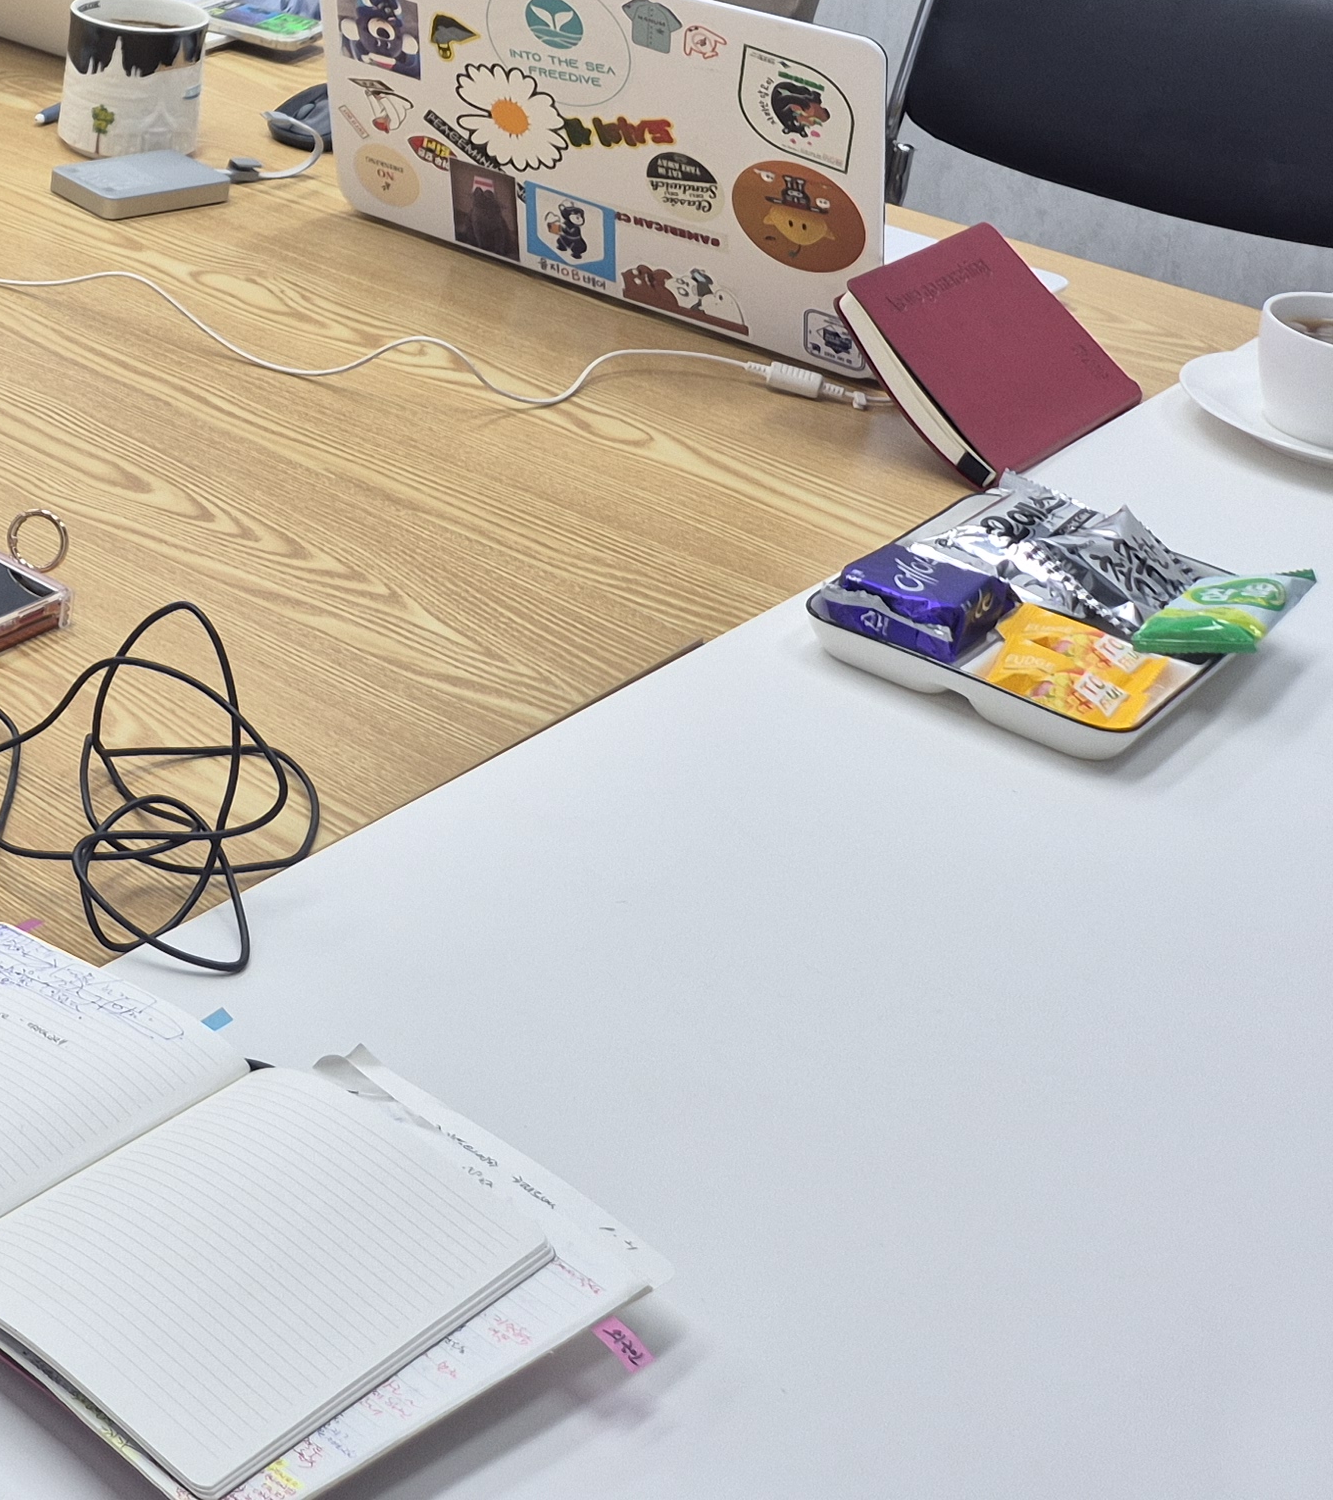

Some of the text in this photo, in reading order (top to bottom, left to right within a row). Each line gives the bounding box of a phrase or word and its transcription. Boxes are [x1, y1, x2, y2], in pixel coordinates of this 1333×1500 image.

[509, 48, 616, 76] INTO THE SEA
[528, 65, 602, 87] FREEDIVE
[377, 168, 394, 181] NO
[650, 179, 718, 199] Sandwich
[662, 195, 712, 213] Classic
